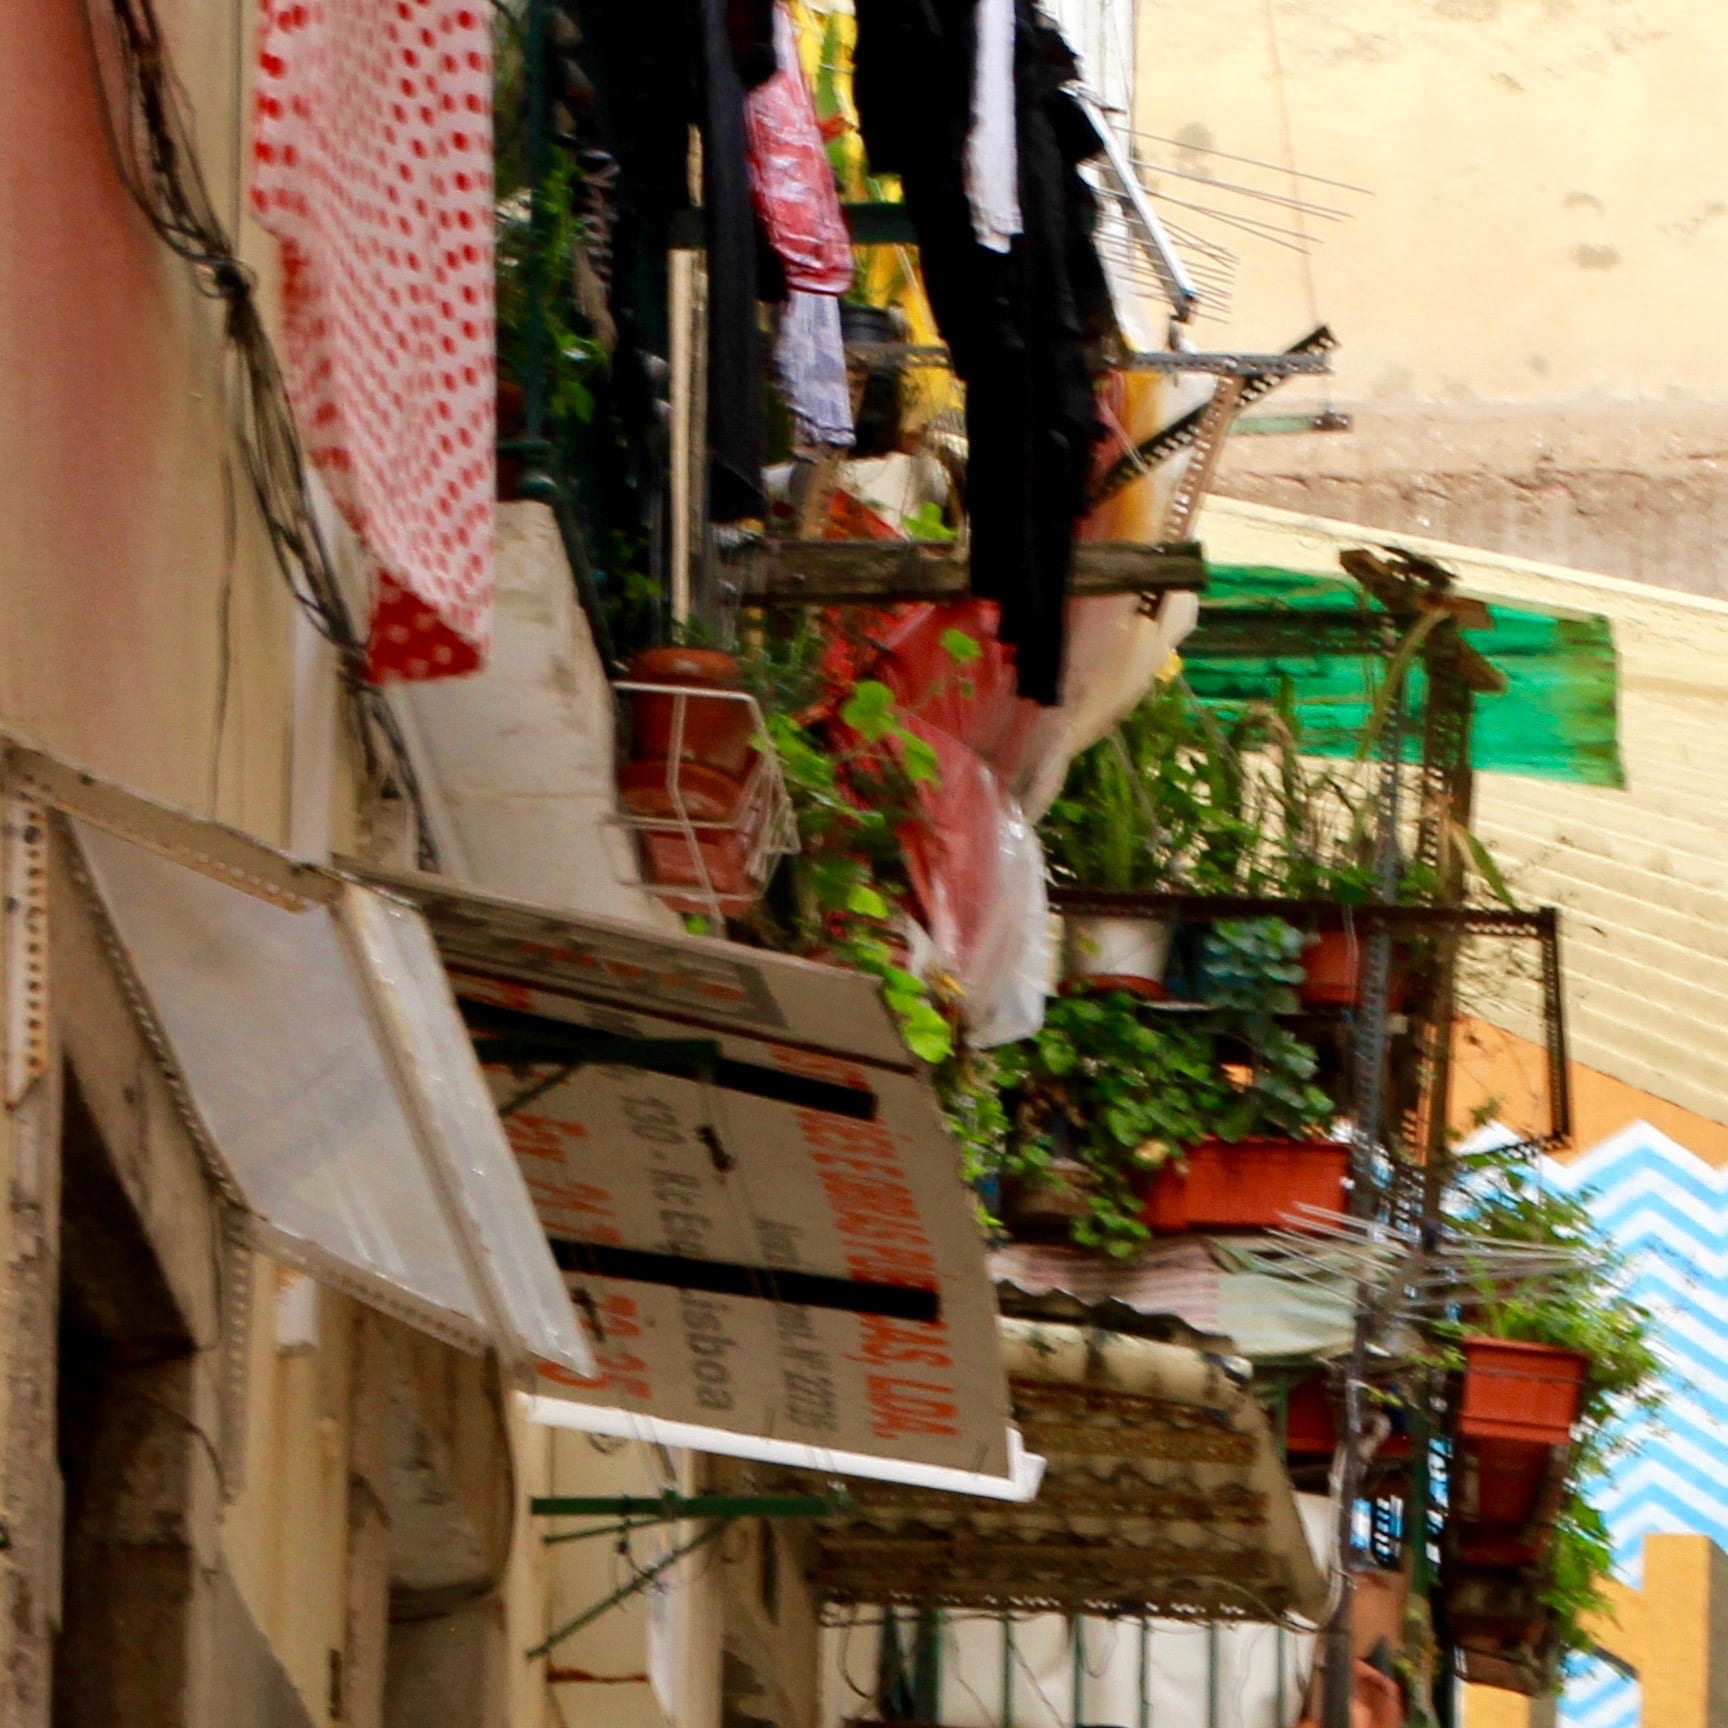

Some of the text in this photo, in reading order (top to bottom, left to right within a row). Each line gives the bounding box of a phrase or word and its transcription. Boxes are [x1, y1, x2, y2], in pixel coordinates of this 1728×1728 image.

[818, 1170, 931, 1246] OBRAS
[678, 1286, 738, 1410] isboa
[865, 1373, 960, 1440] LDA.
